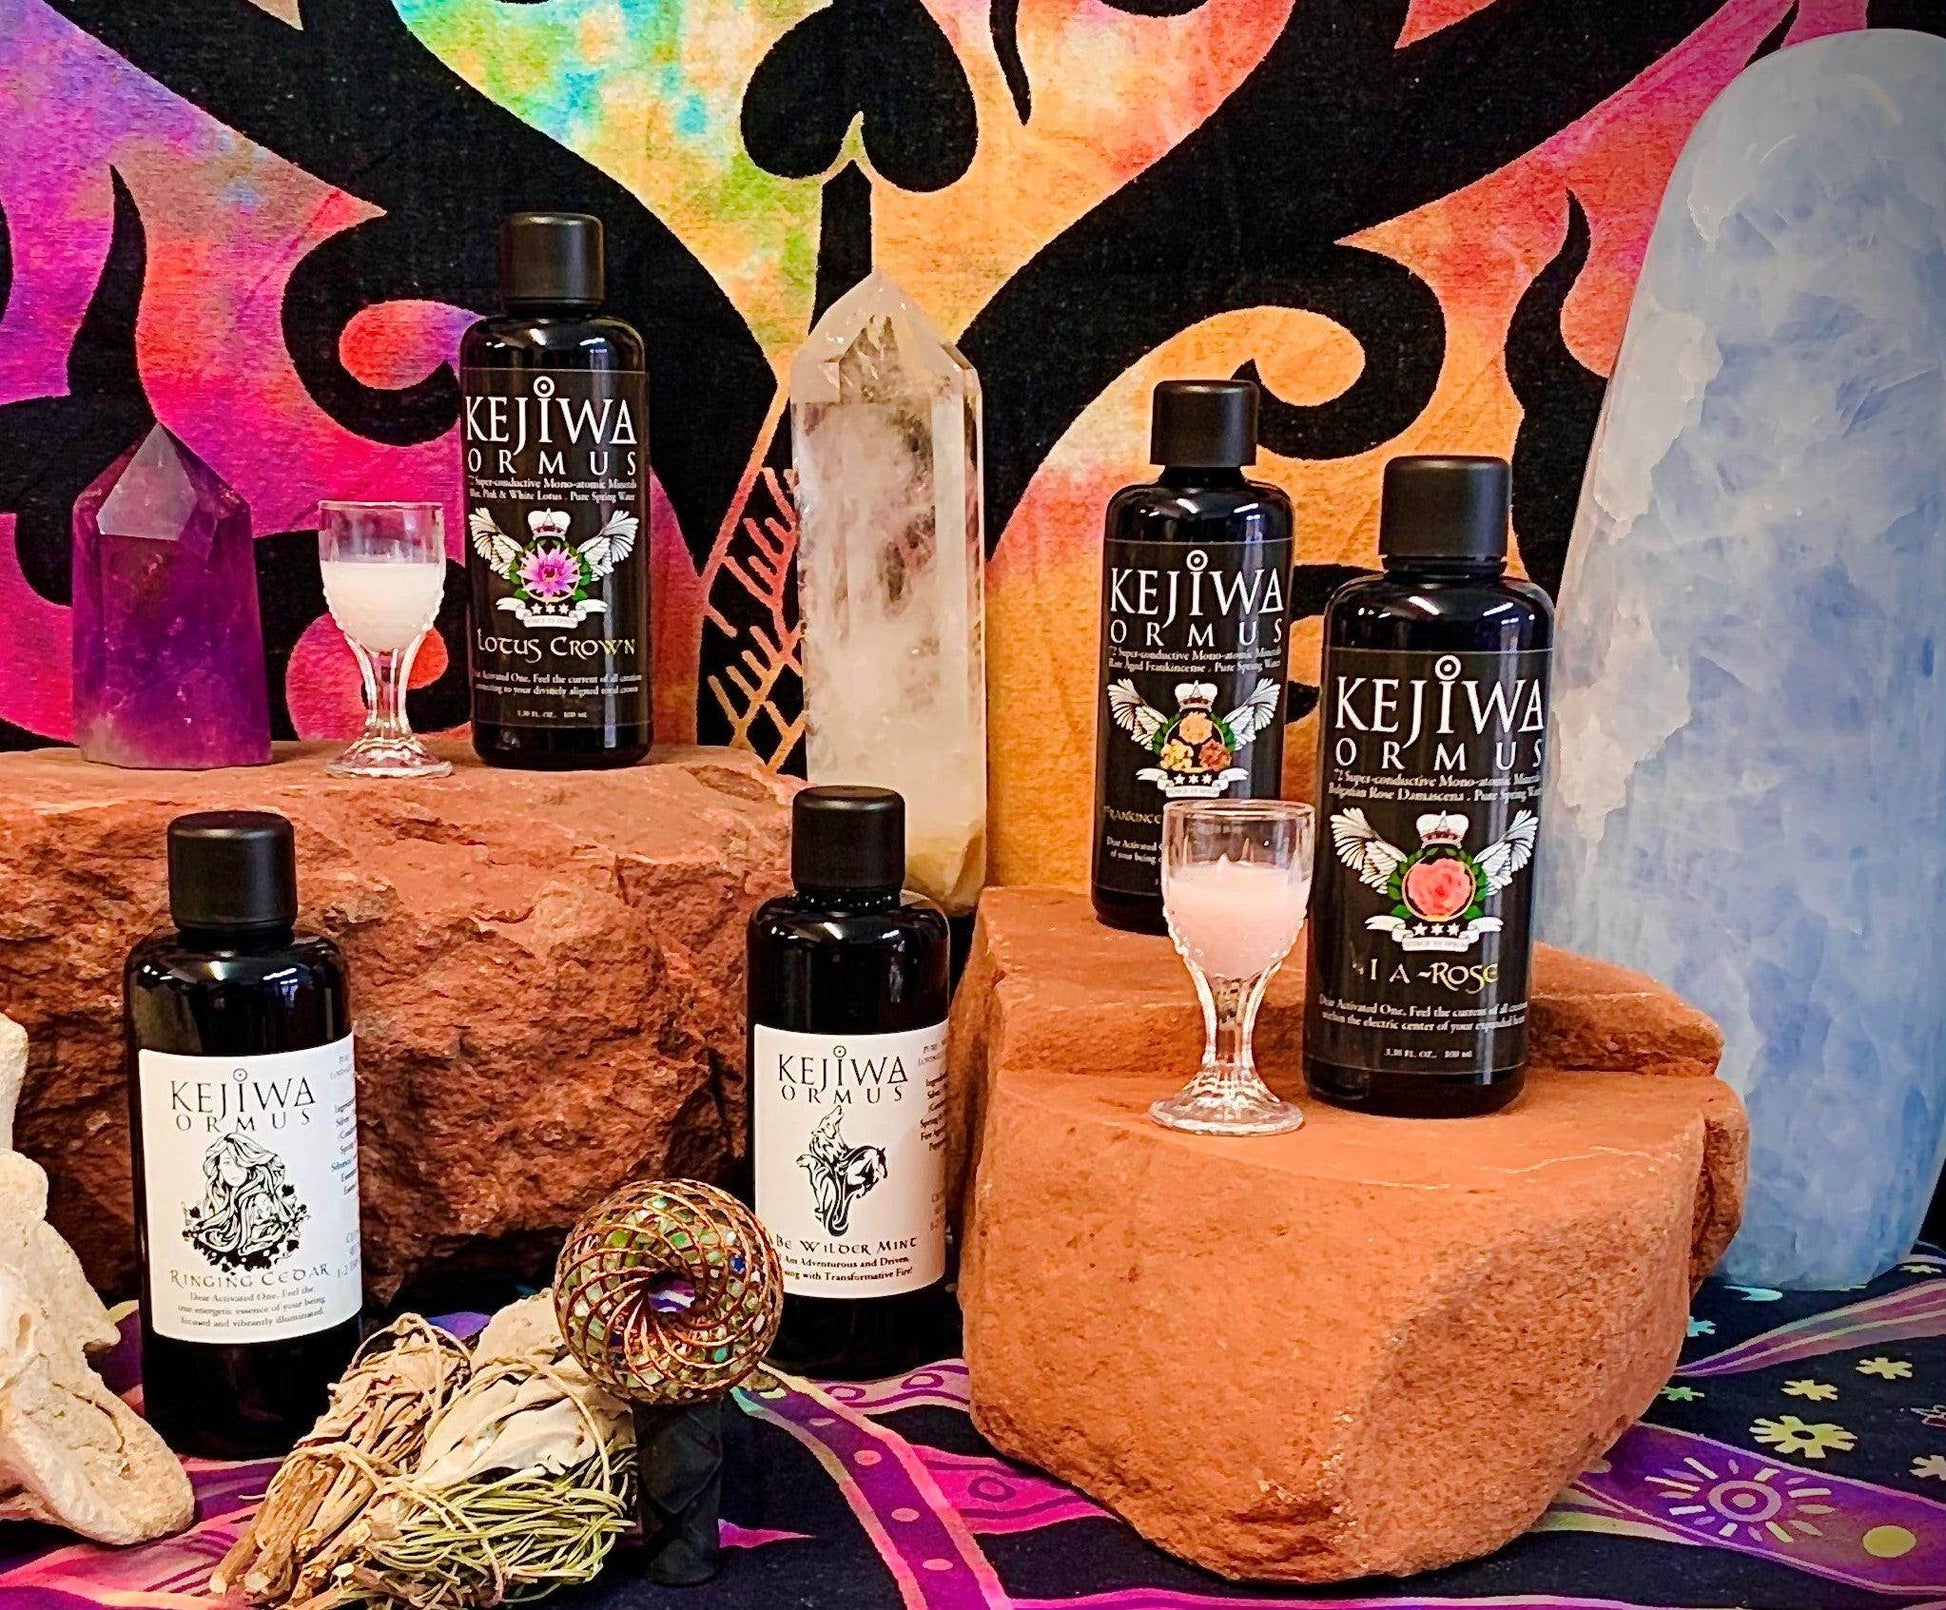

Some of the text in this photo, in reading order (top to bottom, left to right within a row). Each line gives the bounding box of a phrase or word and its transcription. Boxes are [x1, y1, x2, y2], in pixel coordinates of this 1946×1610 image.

[465, 376, 638, 456] KEJIWA
[467, 447, 637, 476] ORMUS
[509, 490, 534, 500] White
[537, 490, 562, 501] Lotus
[1109, 549, 1284, 629] KEJIWA
[1110, 618, 1283, 648] ORMUS
[533, 673, 551, 684] Feel
[552, 673, 567, 684] the
[1335, 655, 1545, 749] KEJIWA
[1335, 737, 1544, 772] ORMUS
[1408, 1005, 1432, 1018] Feel
[1433, 1005, 1451, 1018] the
[1401, 1022, 1435, 1031] center
[1436, 1020, 1450, 1031] of
[1449, 1022, 1474, 1035] your
[778, 1045, 909, 1092] KEJIWA
[170, 1067, 316, 1121] KEJIWA
[781, 1084, 903, 1105] ORMUS
[175, 1107, 312, 1134] ORMUS
[801, 1257, 858, 1269] Adventurous
[859, 1257, 877, 1268] and
[802, 1271, 822, 1281] with
[825, 1270, 894, 1282] Transformative
[213, 1319, 230, 1328] and
